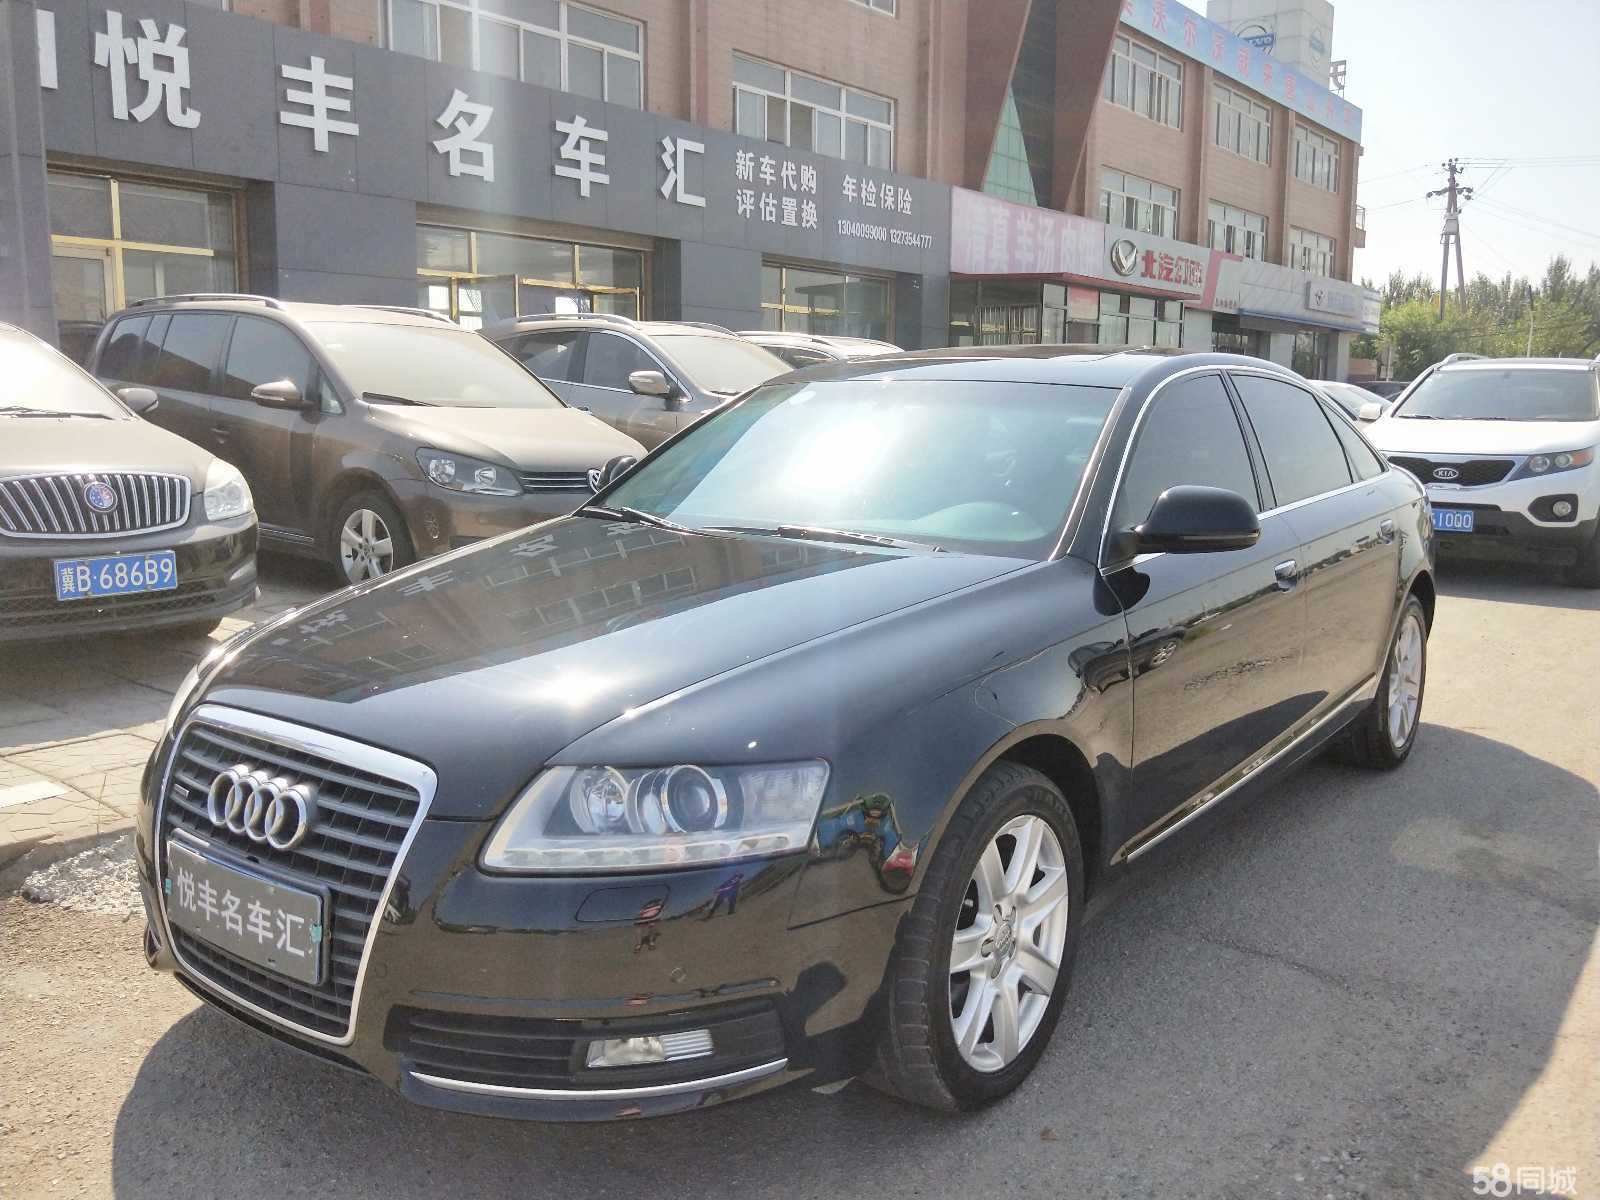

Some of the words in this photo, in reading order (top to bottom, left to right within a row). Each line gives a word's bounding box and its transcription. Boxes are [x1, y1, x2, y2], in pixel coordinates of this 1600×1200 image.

[94, 9, 706, 208] 悦丰名车汇
[735, 149, 817, 195] 新车代购
[842, 173, 913, 216] 年检保险
[736, 188, 818, 230] 评估置换
[177, 867, 305, 957] 悦丰名车汇
